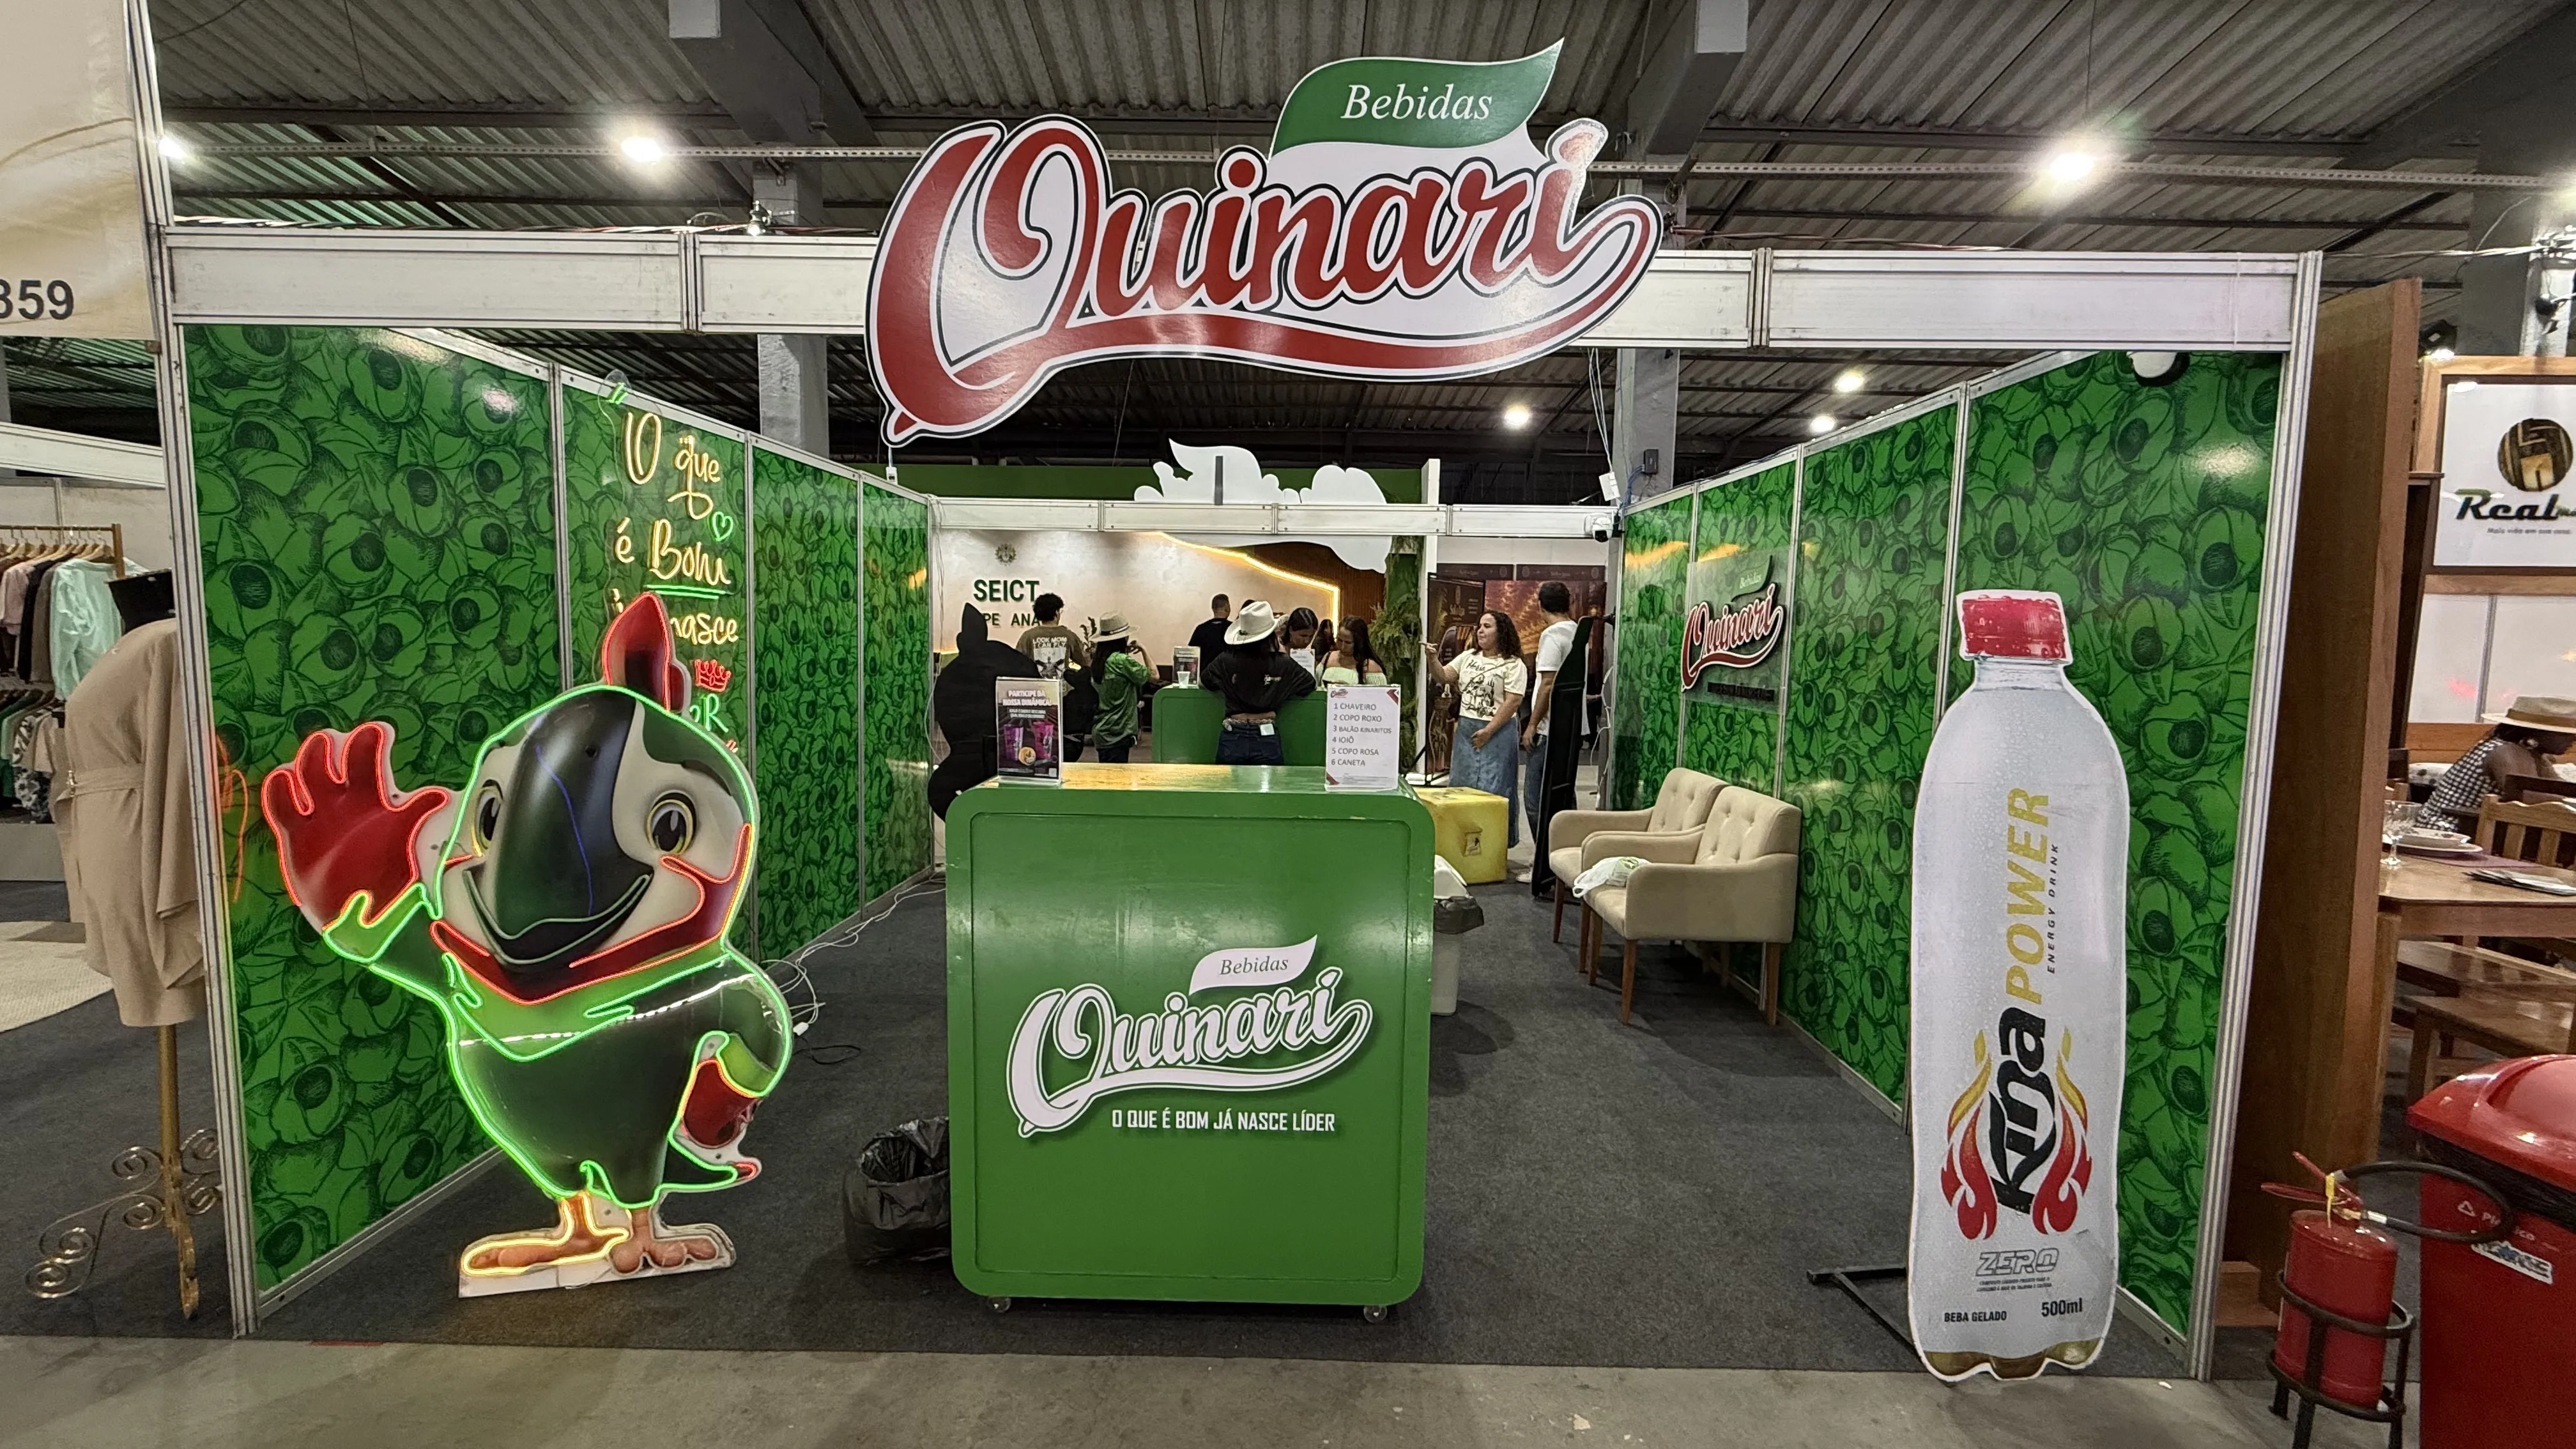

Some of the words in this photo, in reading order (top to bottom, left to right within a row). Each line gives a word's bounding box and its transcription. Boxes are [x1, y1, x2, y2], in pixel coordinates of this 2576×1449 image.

[1342, 84, 1493, 121] Bebidas
[874, 118, 1656, 441] Quinari
[625, 412, 662, 485] O
[668, 435, 721, 519] que
[2455, 488, 2559, 520] Real
[615, 517, 635, 564] é
[649, 518, 732, 586] Bom
[973, 579, 1040, 602] SEICT
[1682, 583, 1784, 692] Quinari
[2048, 843, 2058, 898] DRINK
[2005, 787, 2049, 1005] POWER
[2046, 908, 2057, 974] ENERGY
[1220, 956, 1289, 976] Bebidas
[1008, 967, 1372, 1137] Quinari
[1112, 1110, 1123, 1128] O
[1127, 1110, 1158, 1128] QUE
[1162, 1107, 1171, 1129] É
[1176, 1110, 1209, 1130] BOM
[1213, 1107, 1233, 1130] JÁ
[1238, 1112, 1288, 1131] NASCE
[1292, 1109, 1335, 1131] LÍDER
[1975, 1248, 2060, 1276] ZERO
[1944, 1312, 1969, 1322] BEBA
[1972, 1310, 2007, 1322] GELADO
[2041, 1297, 2083, 1317] 500ml
